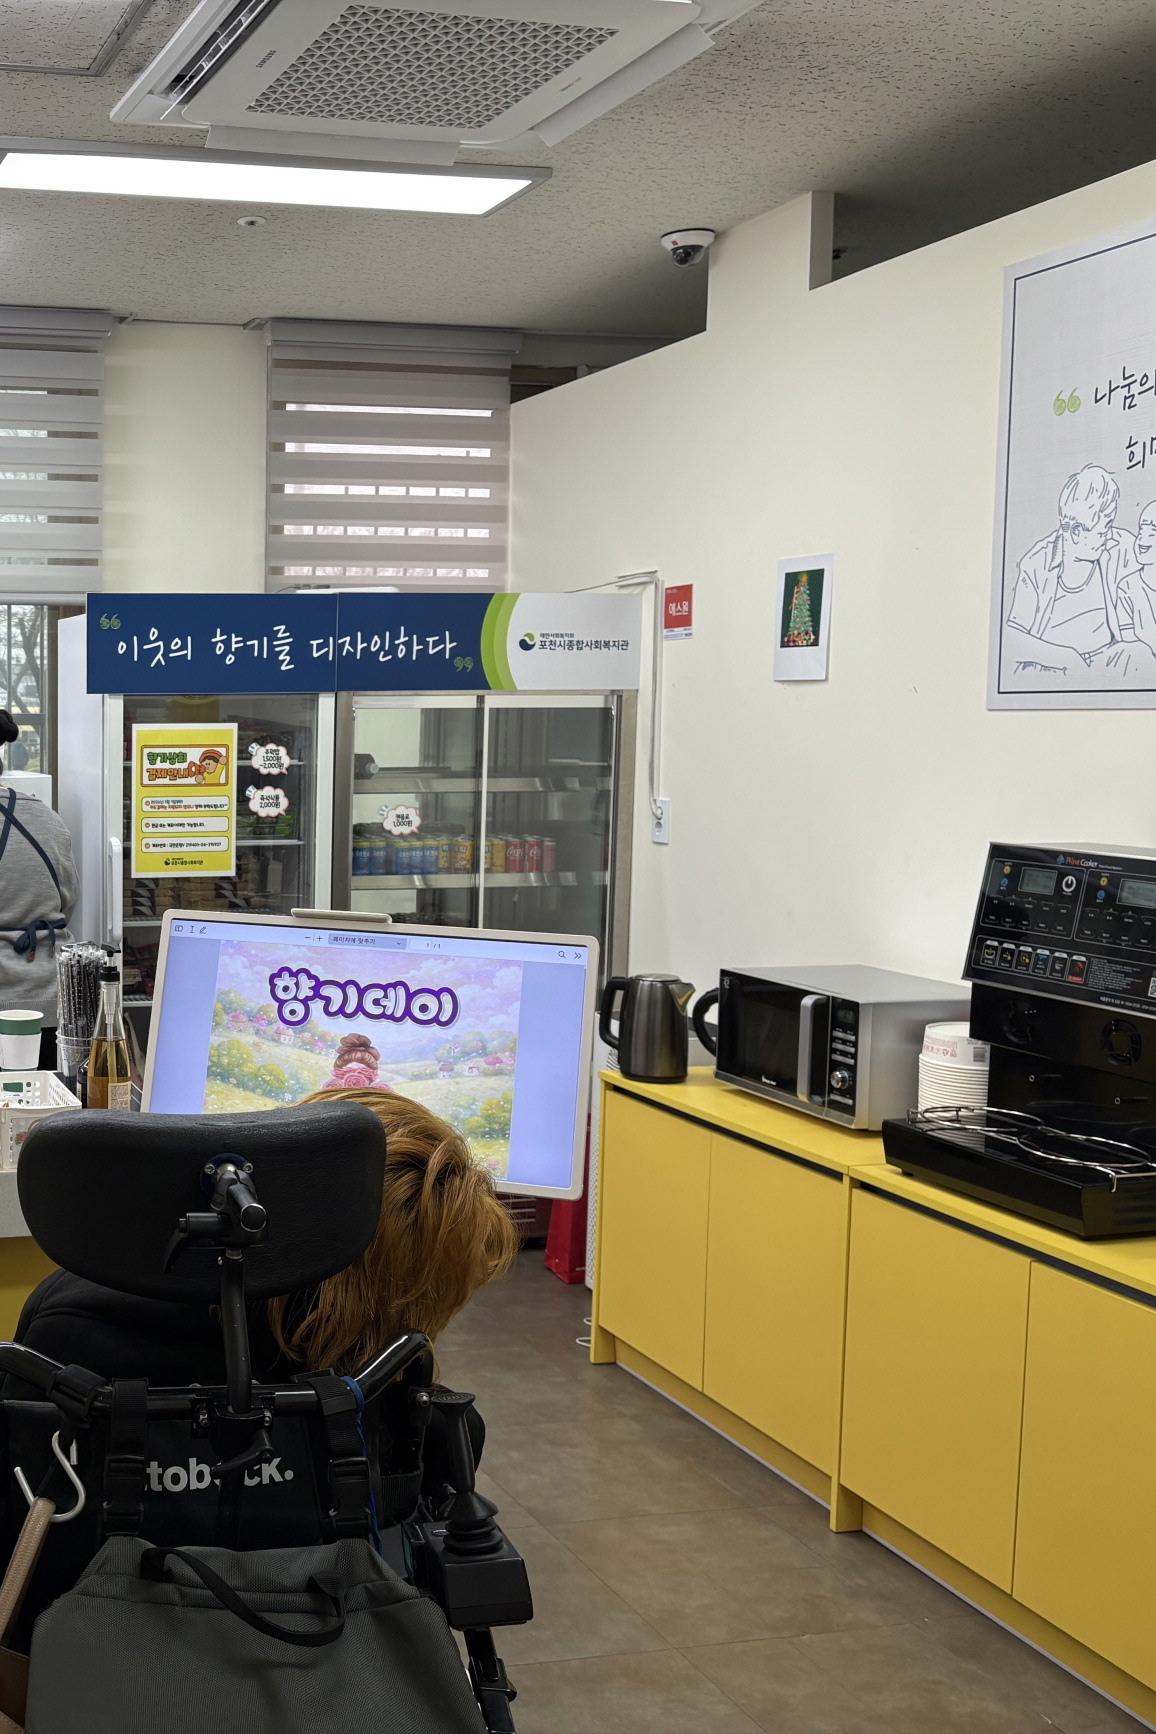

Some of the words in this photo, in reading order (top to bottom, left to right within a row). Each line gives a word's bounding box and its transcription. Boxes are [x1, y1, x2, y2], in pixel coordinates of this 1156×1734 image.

[668, 601, 689, 616] 에스원
[117, 627, 192, 668] 이웃의
[211, 625, 295, 671] 향기를
[310, 627, 457, 663] 디자인하다
[538, 640, 629, 651] 포천시종합사회복지관
[146, 751, 187, 766] 향기상회
[146, 767, 189, 781] 결제안내
[269, 967, 461, 1027] 향기데이
[145, 1457, 294, 1493] tobck.
